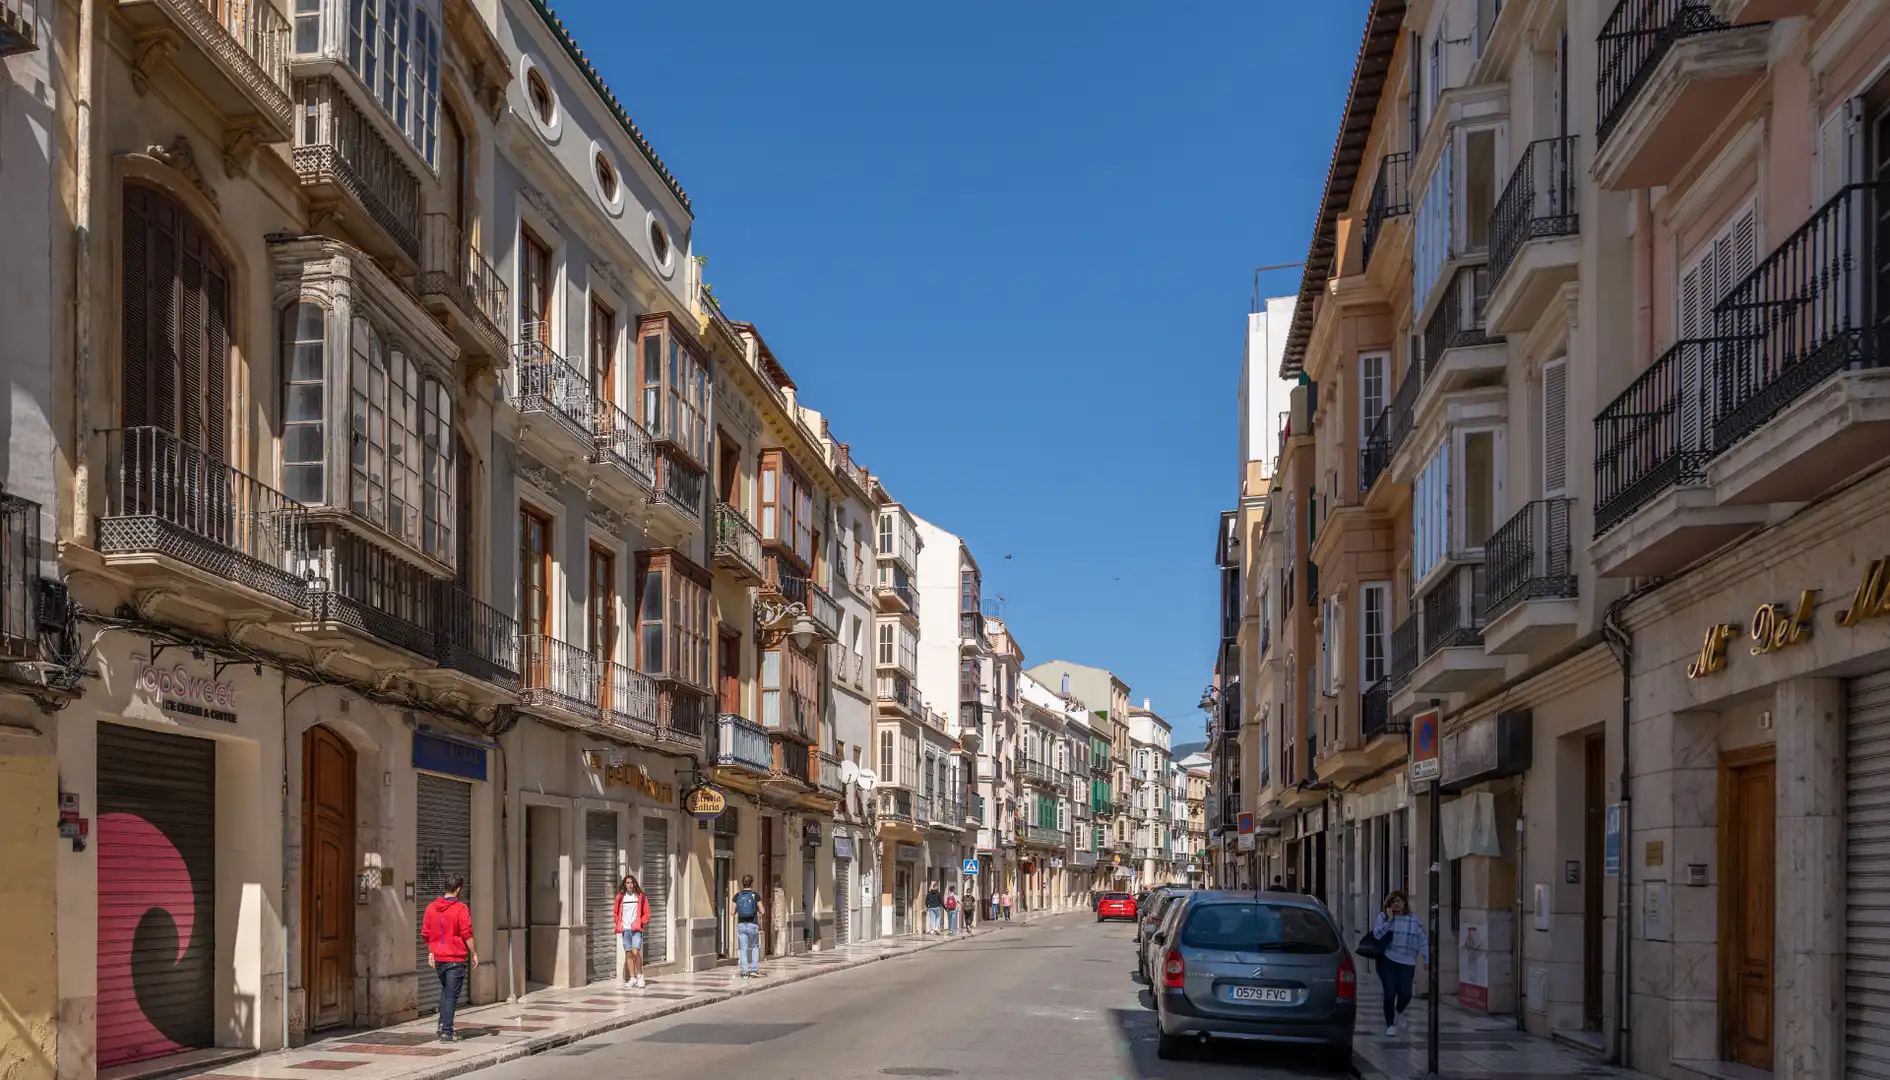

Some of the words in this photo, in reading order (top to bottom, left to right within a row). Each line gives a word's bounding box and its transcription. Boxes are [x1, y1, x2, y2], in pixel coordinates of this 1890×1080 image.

[1751, 589, 1815, 655] Del
[1835, 555, 1890, 627] M
[1236, 987, 1263, 999] 0579
[1266, 989, 1287, 1000] FVC
